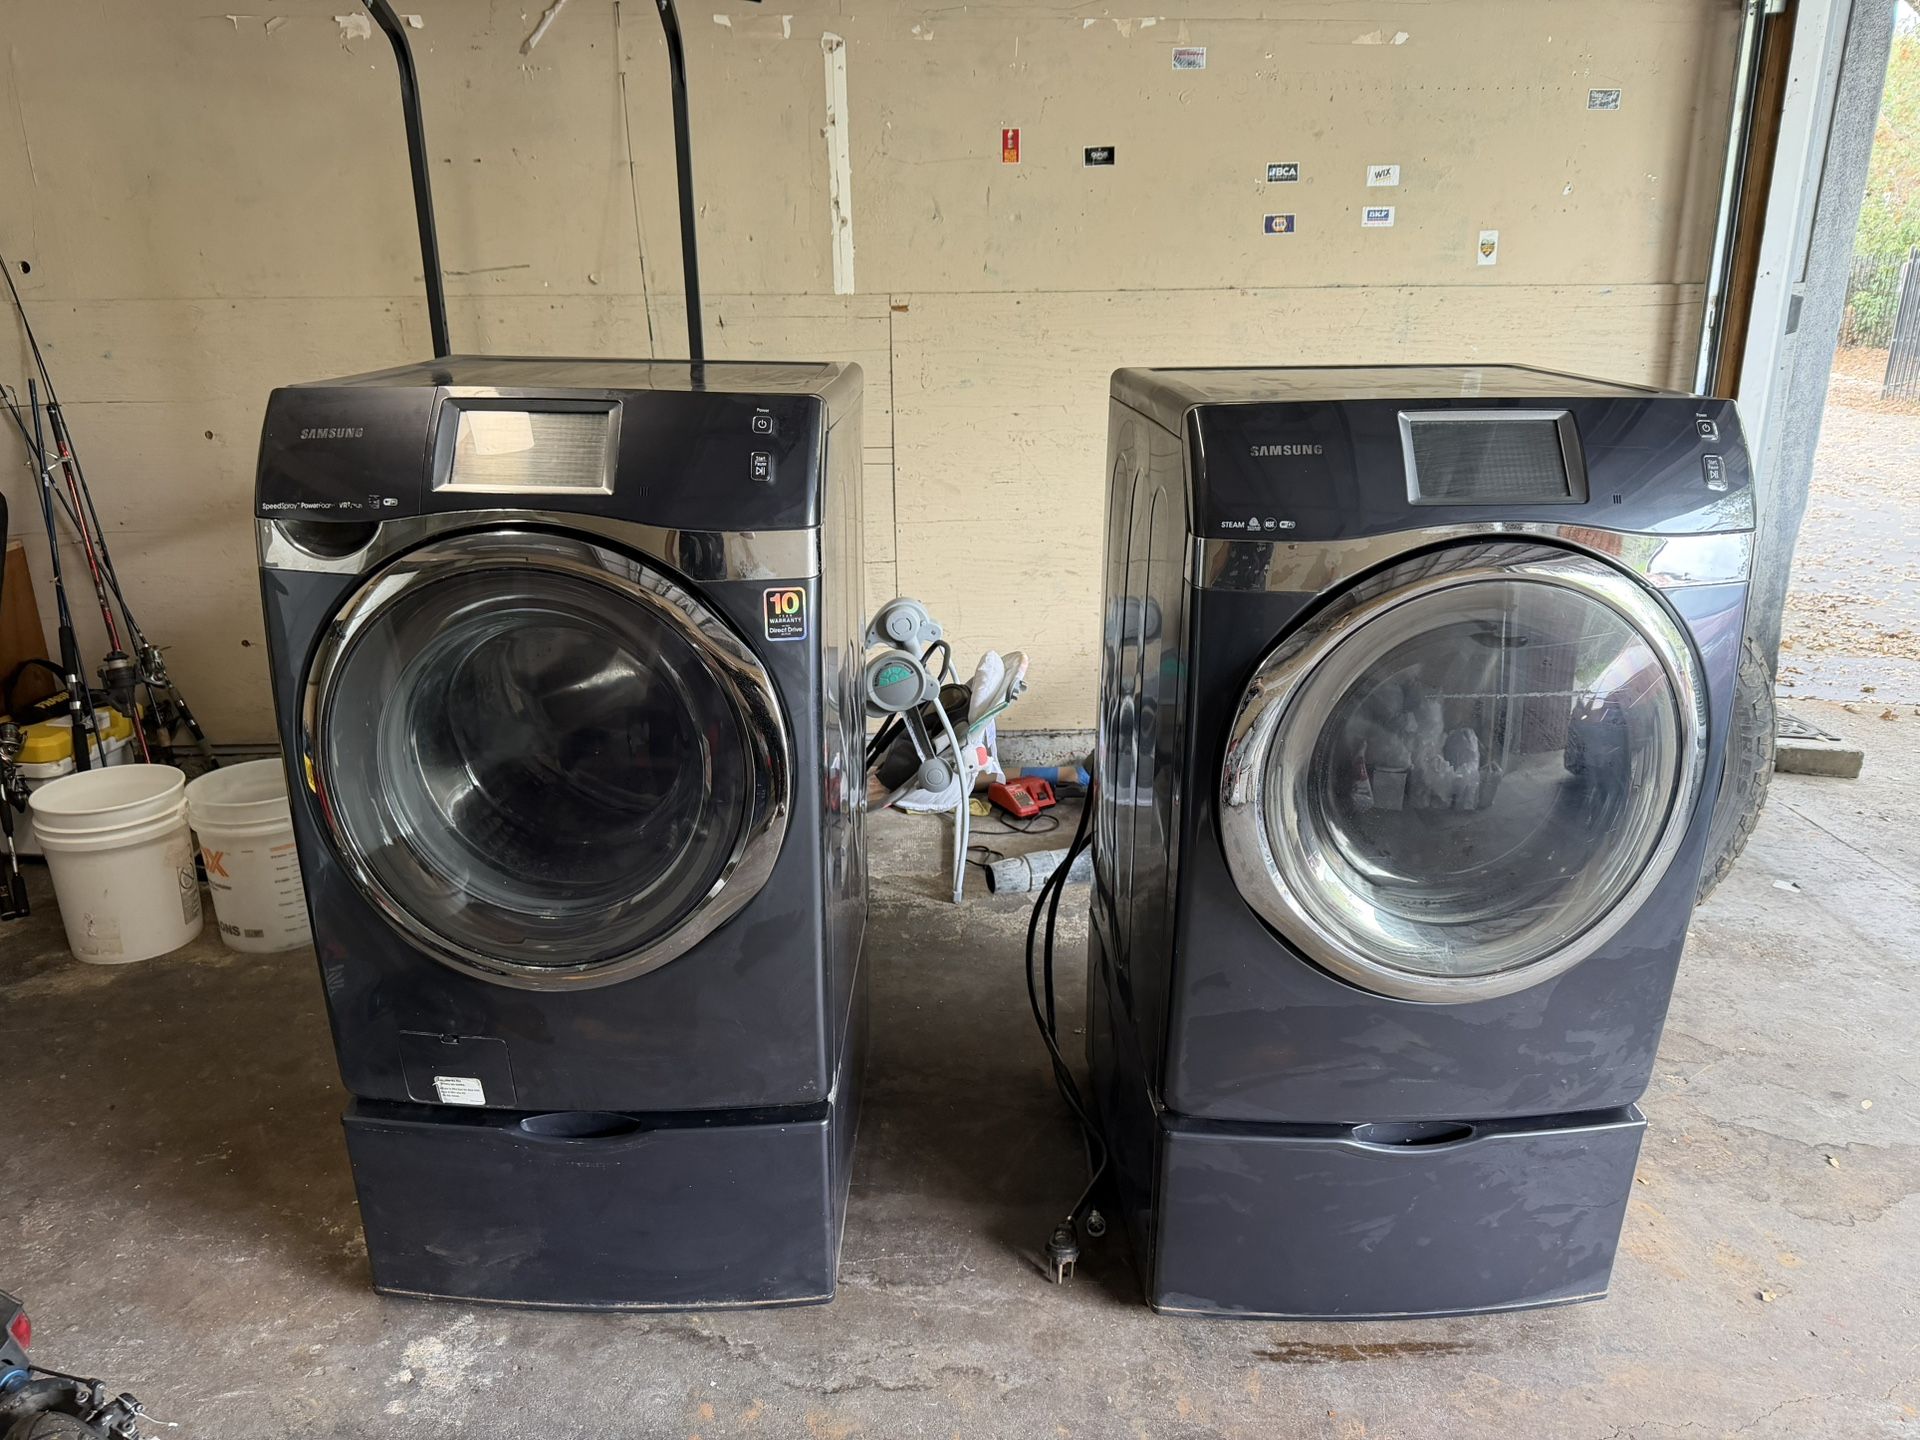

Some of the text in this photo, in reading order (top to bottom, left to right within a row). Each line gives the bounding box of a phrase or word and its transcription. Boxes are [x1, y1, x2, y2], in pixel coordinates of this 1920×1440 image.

[1276, 167, 1297, 176] BCA
[1374, 168, 1391, 178] WIX
[300, 427, 364, 440] SAMSUNG
[1249, 444, 1323, 457] SAMSUNG
[1221, 521, 1245, 529] STEAM
[769, 592, 800, 615] 10
